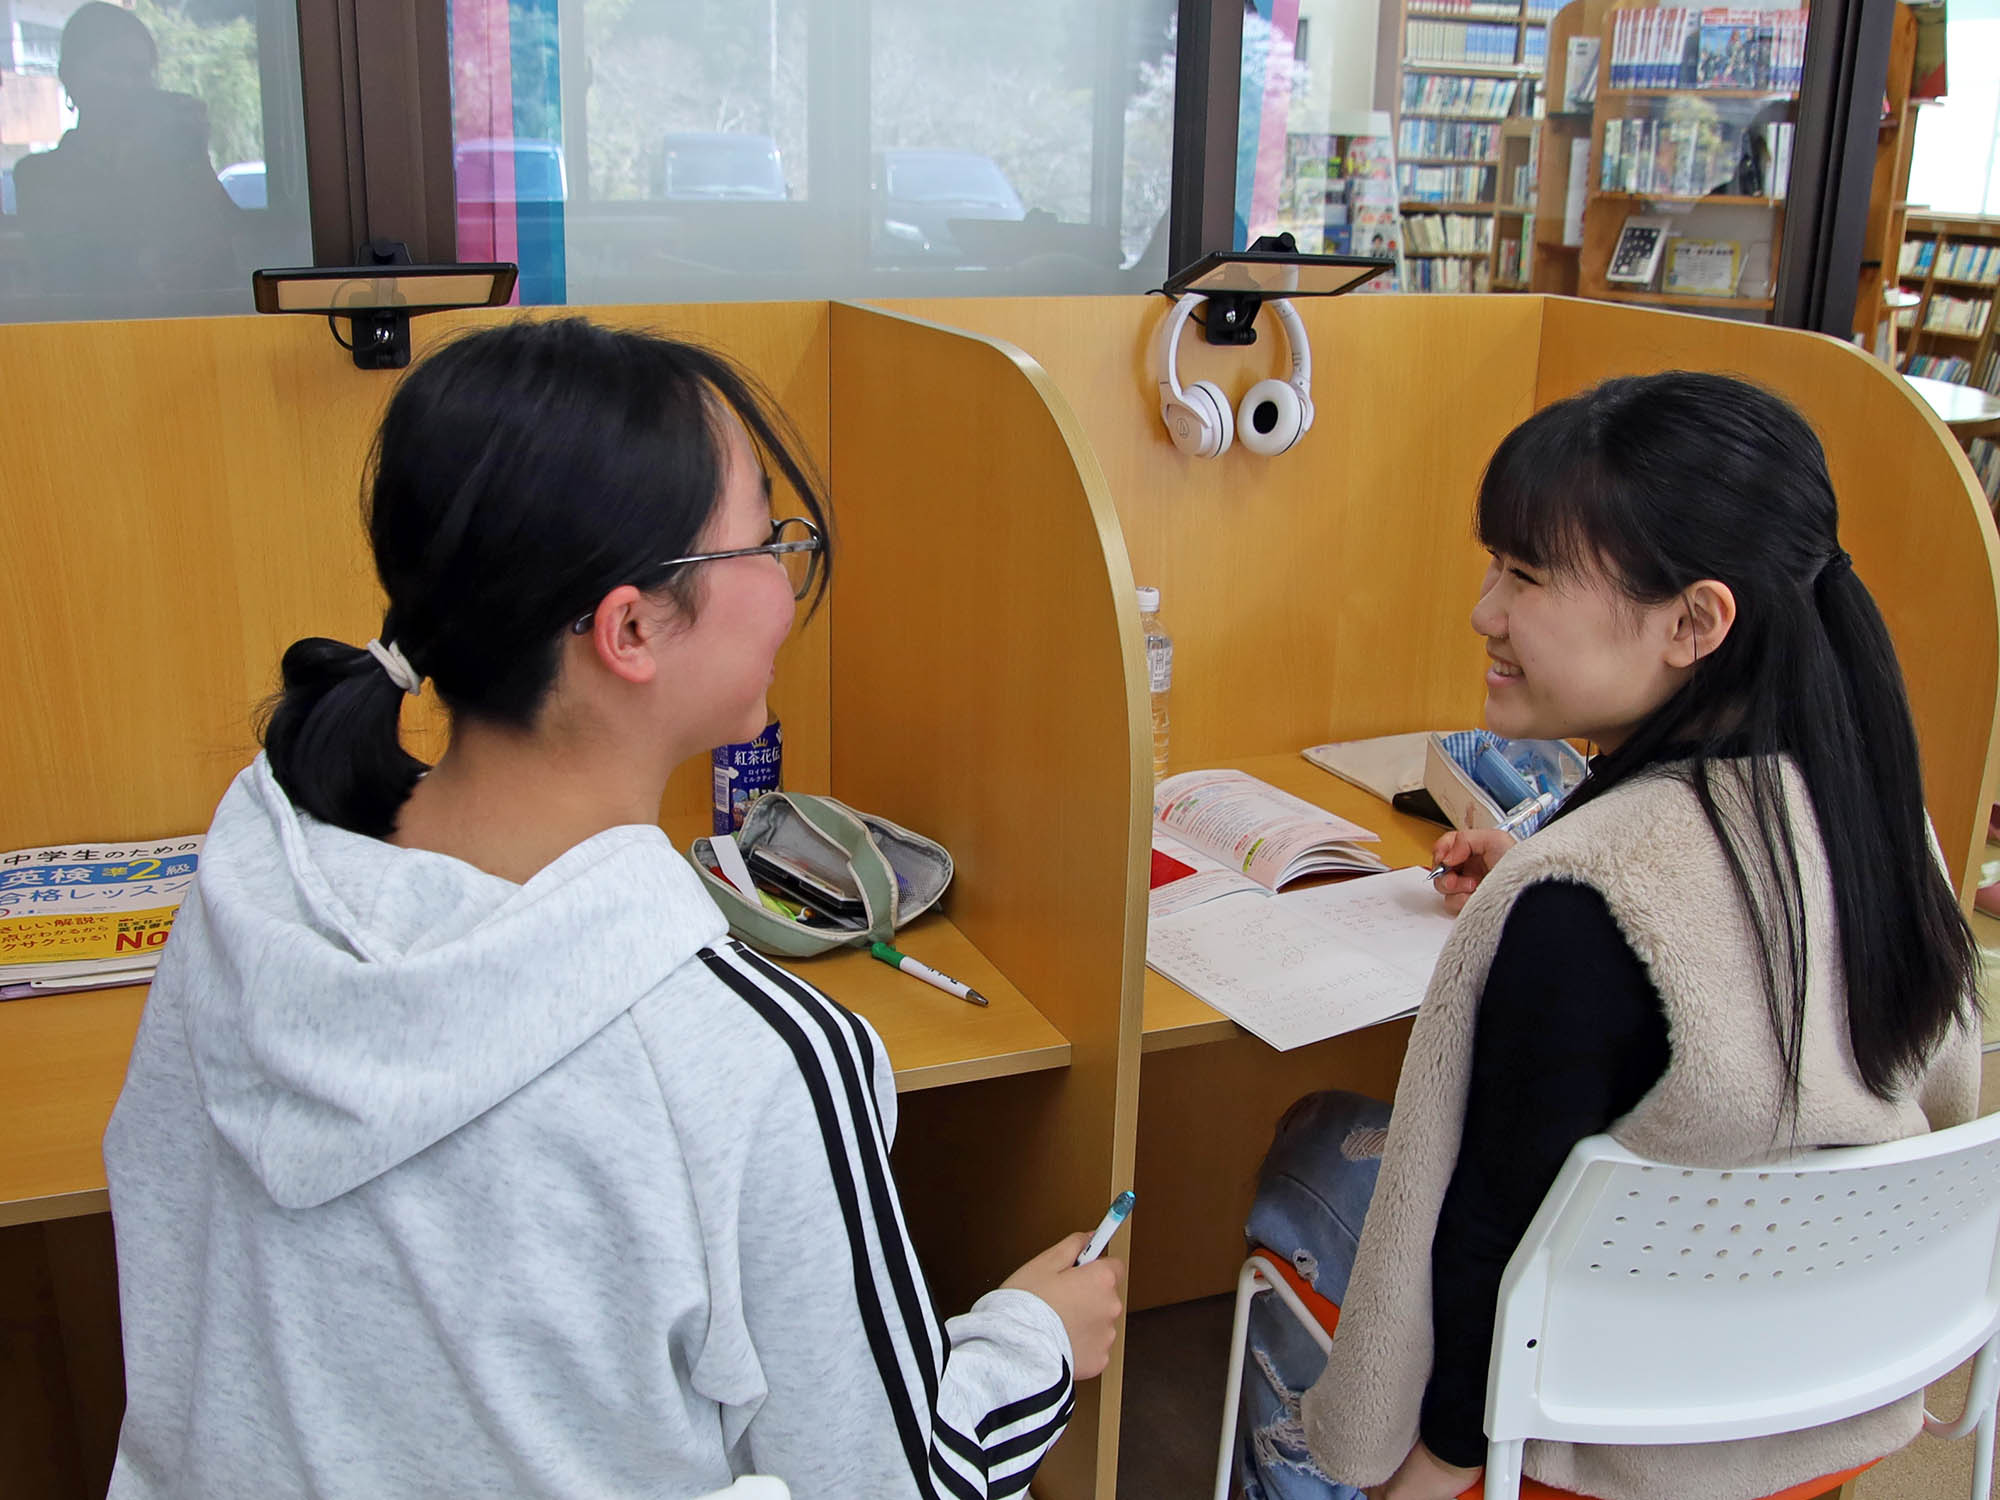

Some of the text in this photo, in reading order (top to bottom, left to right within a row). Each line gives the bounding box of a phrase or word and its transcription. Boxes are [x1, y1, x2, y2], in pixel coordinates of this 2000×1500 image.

[734, 746, 781, 766] 紅茶花伝
[743, 774, 776, 784] ミルクティー
[748, 768, 772, 776] ロイヤル
[4, 843, 197, 866] 中学生のための
[0, 881, 191, 906] 合格レッスン
